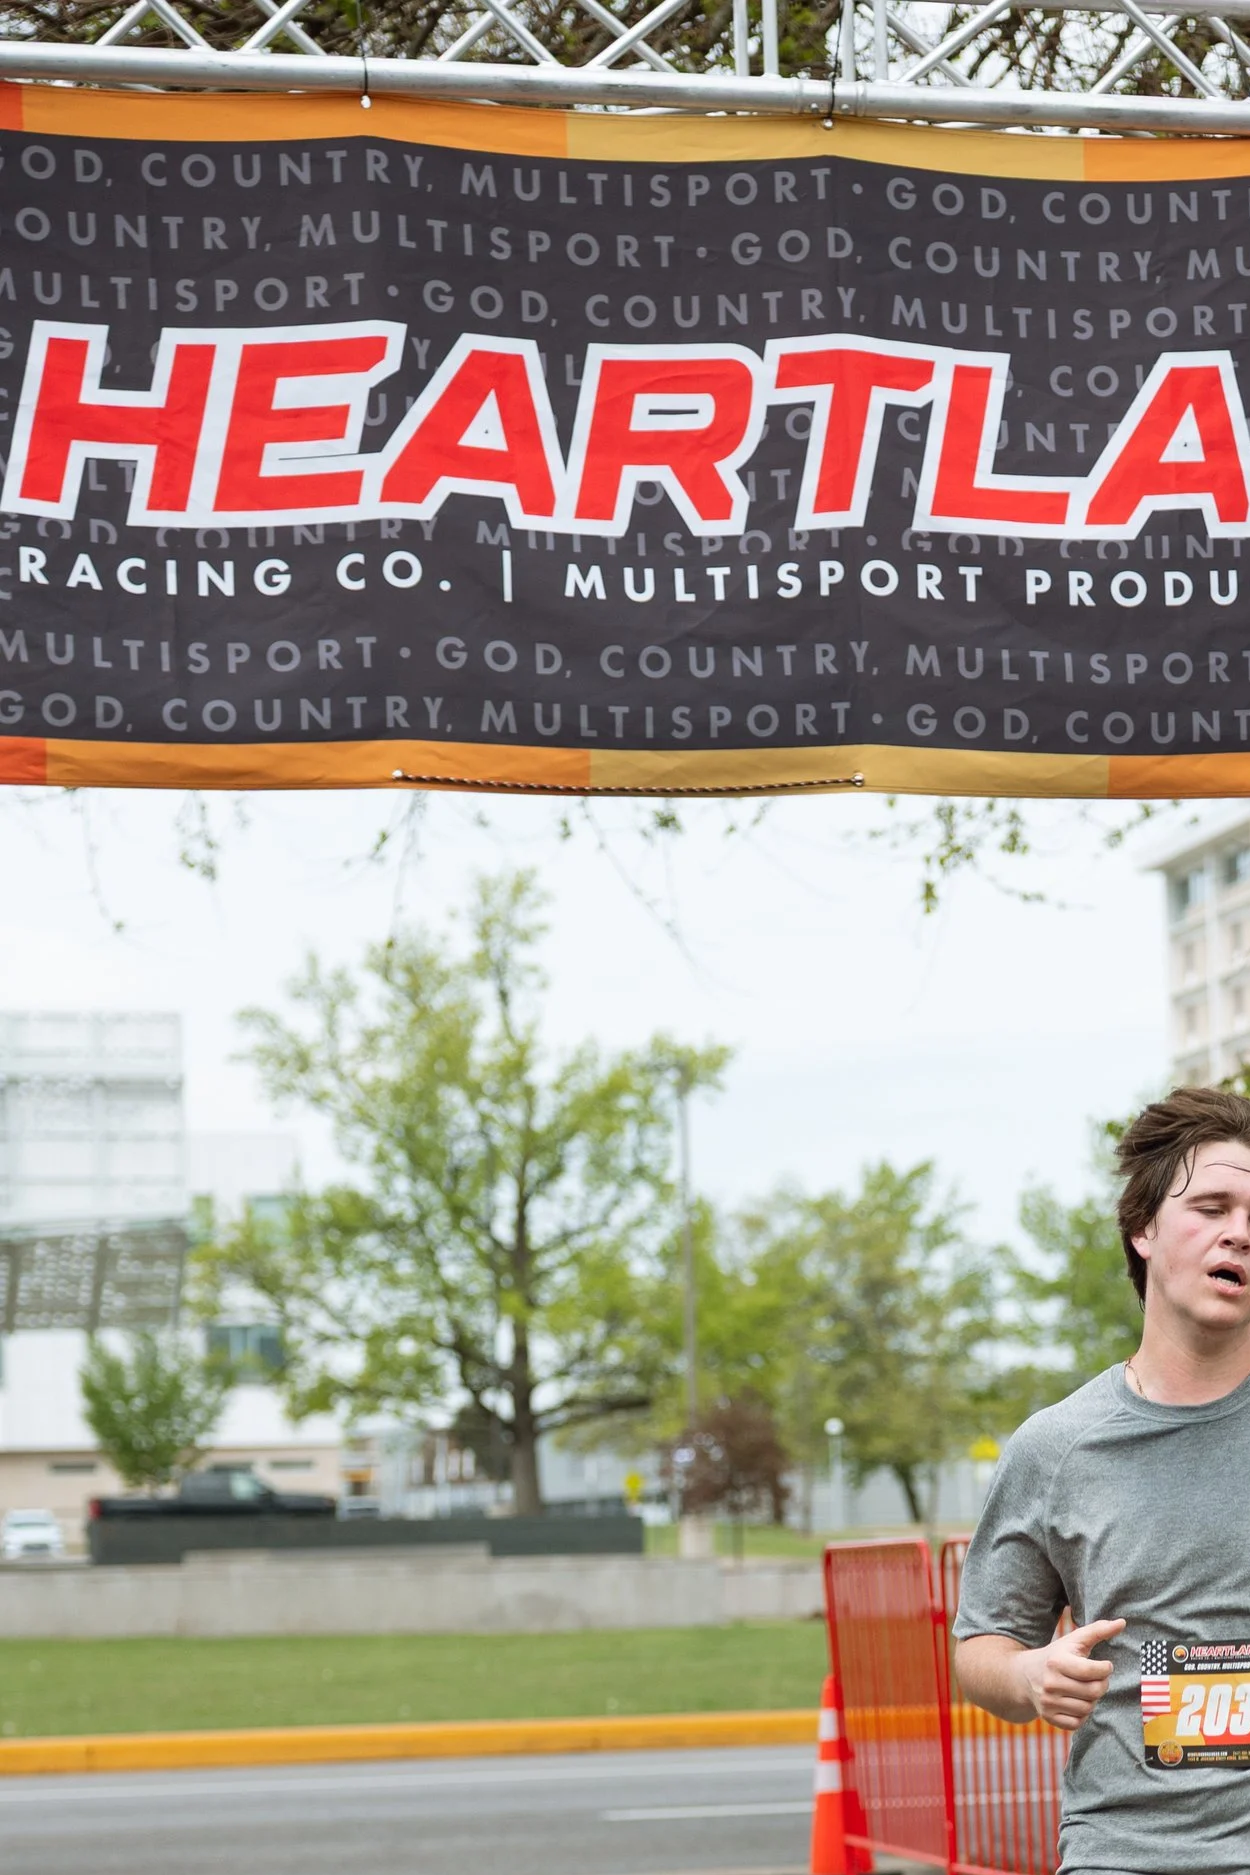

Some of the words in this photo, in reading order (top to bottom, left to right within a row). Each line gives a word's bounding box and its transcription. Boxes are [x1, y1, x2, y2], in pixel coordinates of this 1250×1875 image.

[0, 145, 112, 187] OD,
[142, 148, 433, 192] COUNTRY,
[460, 162, 831, 207] MULTISPORT
[886, 177, 1016, 224] GOD,
[299, 211, 675, 268] MULTISPORT
[731, 227, 863, 265] GOD,
[888, 237, 1162, 284] COUNTRY,
[422, 279, 557, 327] GOD,
[585, 287, 866, 328] COUNTRY,
[891, 294, 1247, 340] MULTISPORT
[19, 546, 292, 596] RACING
[336, 550, 452, 591] CO.
[564, 559, 984, 602] MULTISPORT
[436, 637, 572, 678] GOD,
[600, 641, 879, 679] COUNTRY,
[162, 696, 453, 732] COUNTRY,
[481, 700, 851, 739] MULTISPORT
[907, 703, 1039, 744] GOD,
